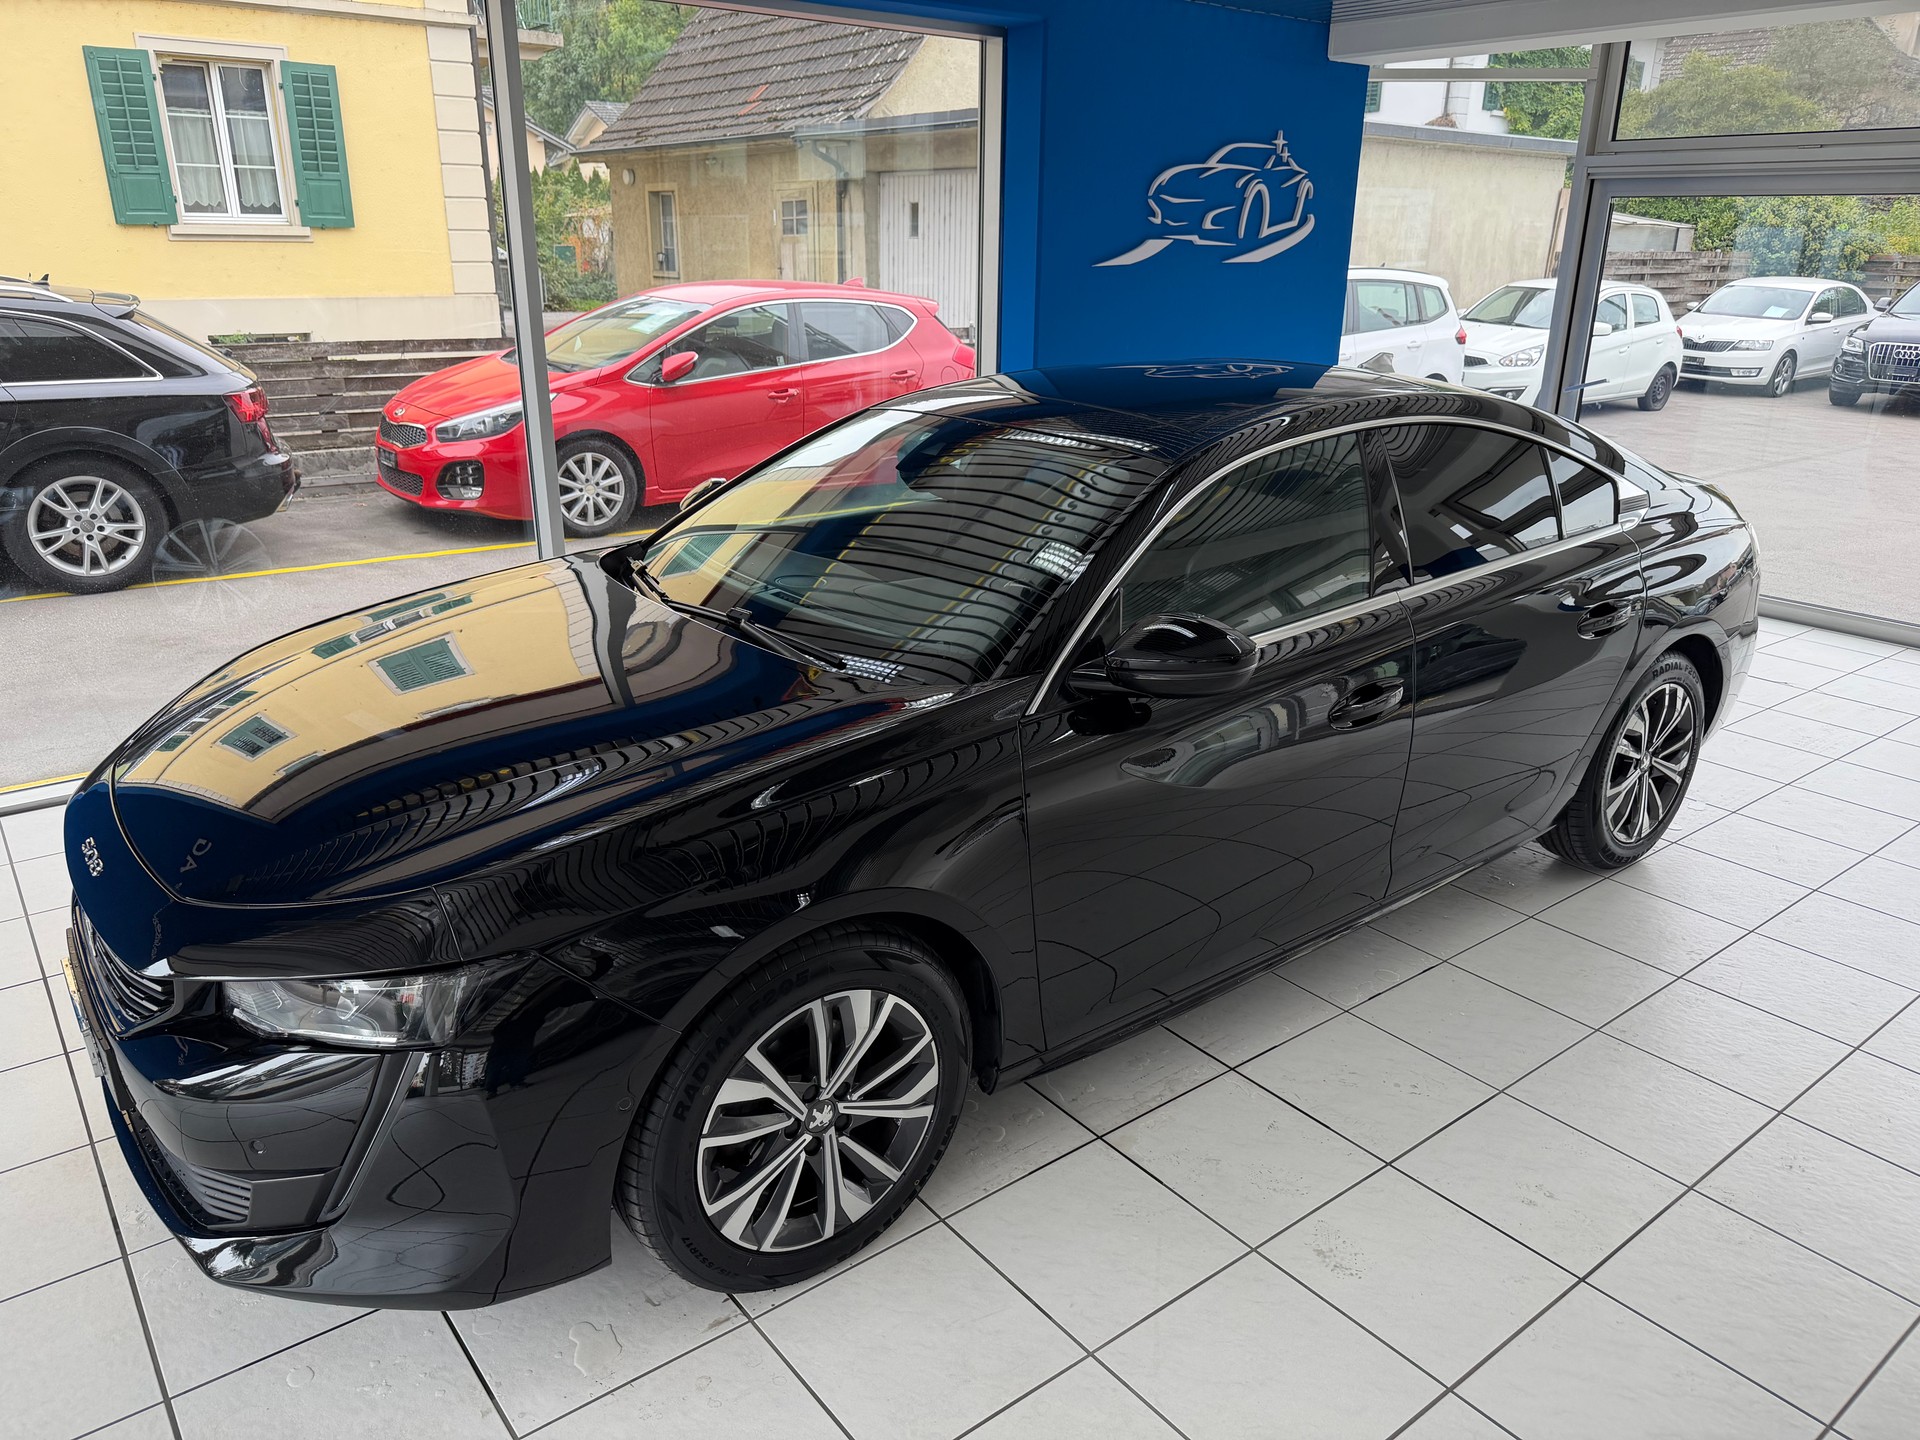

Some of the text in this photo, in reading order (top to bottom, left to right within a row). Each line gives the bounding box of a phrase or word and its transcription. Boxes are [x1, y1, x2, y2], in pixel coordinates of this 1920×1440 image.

[1651, 661, 1683, 681] RADIAL
[81, 836, 104, 877] 508
[672, 1022, 743, 1122] RADIAL
